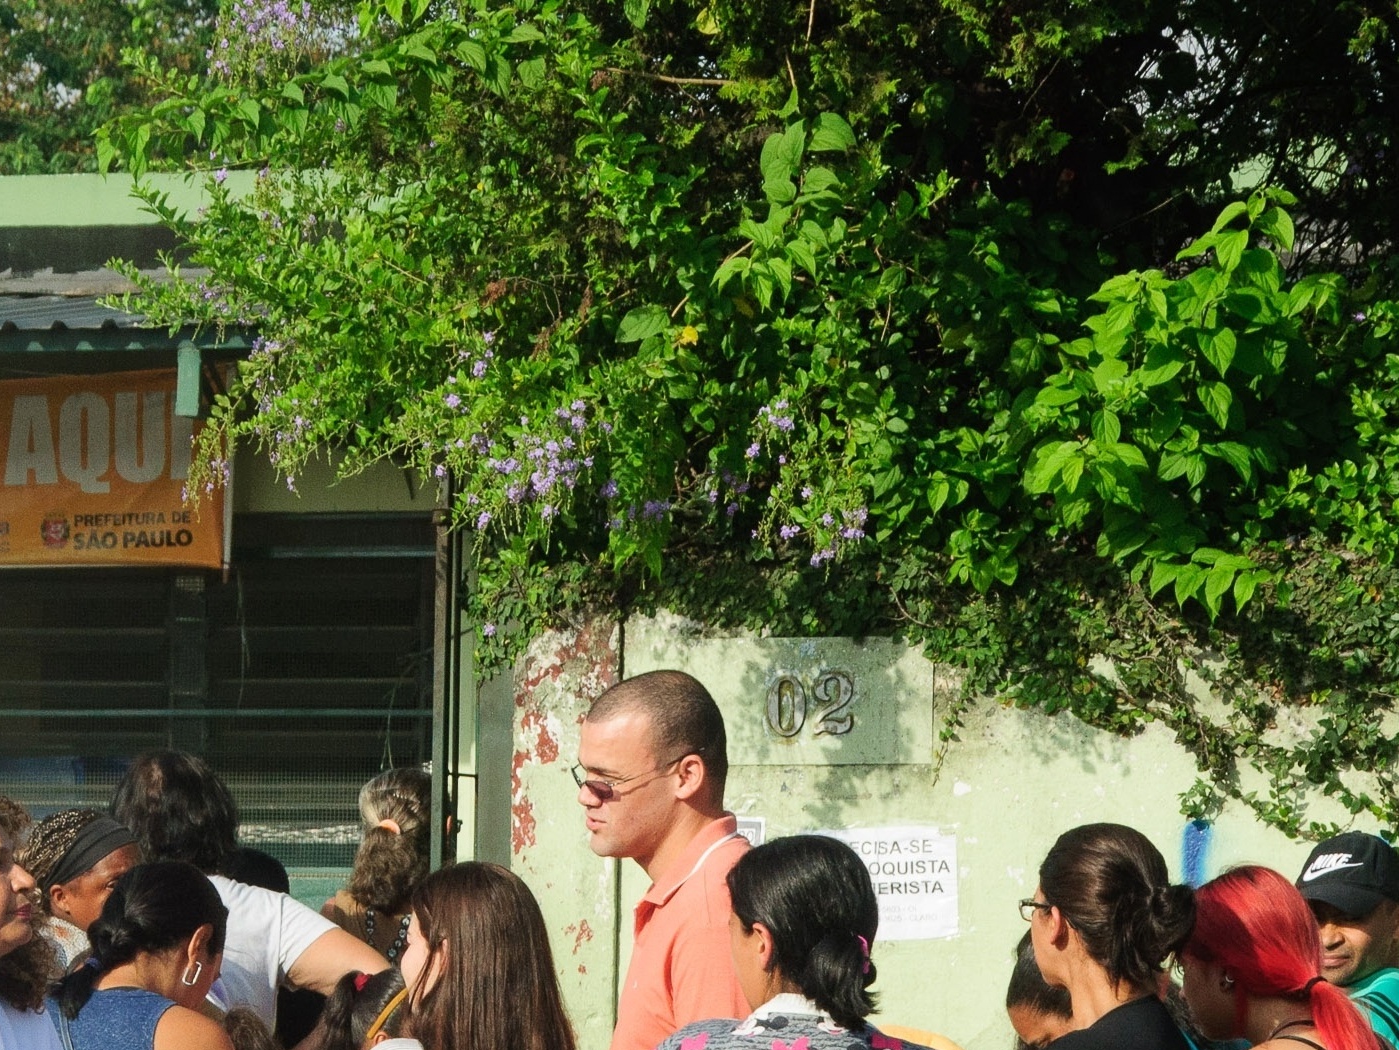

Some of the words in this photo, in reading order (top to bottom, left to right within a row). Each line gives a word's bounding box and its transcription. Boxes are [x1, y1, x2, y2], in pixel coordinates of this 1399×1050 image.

[4, 391, 195, 494] AQUI
[74, 513, 165, 527] PREFEITURA
[171, 511, 191, 524] DE
[73, 526, 118, 550] SÃO
[122, 528, 194, 549] PAULO
[766, 671, 854, 738] 02
[849, 839, 933, 855] ECISA-SE
[868, 859, 951, 876] OQUISTA
[1311, 852, 1353, 872] NIKE
[872, 880, 944, 895] ERISTA
